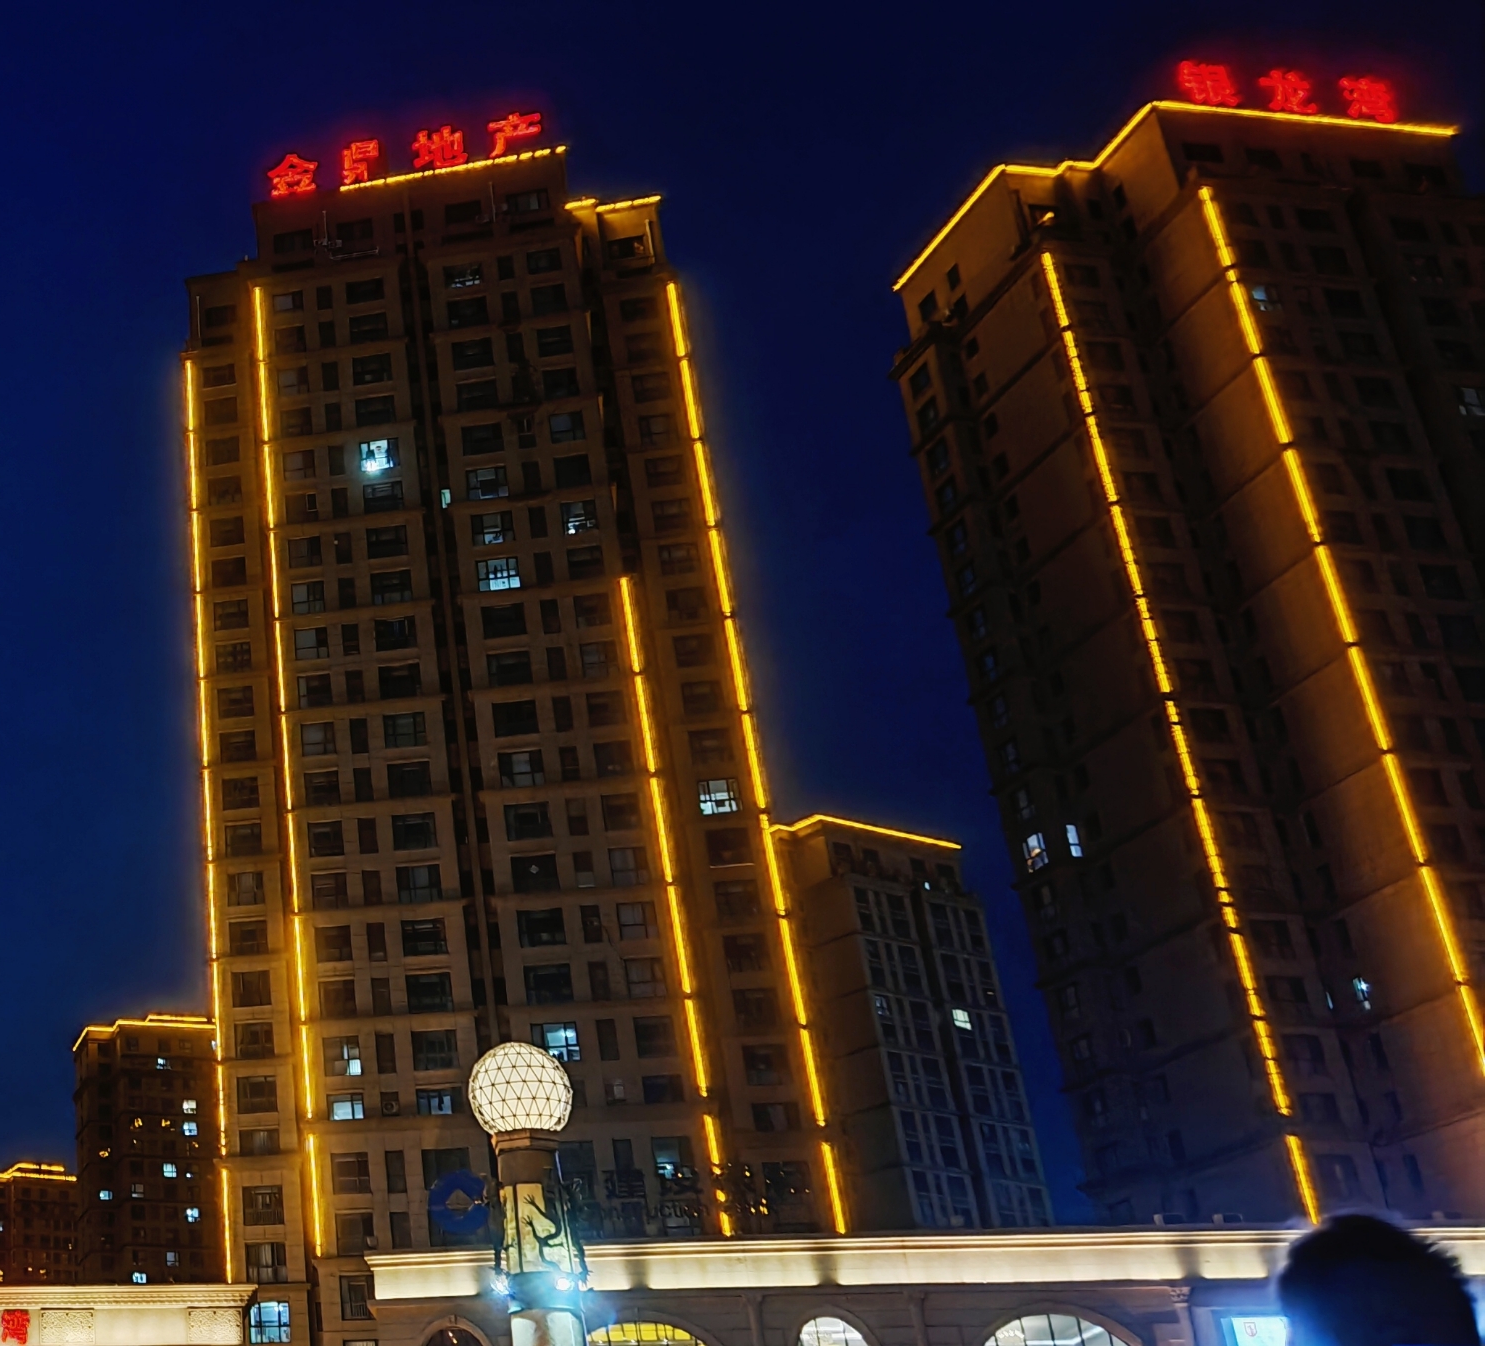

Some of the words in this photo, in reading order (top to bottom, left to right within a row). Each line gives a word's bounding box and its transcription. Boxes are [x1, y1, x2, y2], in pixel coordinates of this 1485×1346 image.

[1179, 60, 1396, 123] 银龙湾
[267, 112, 542, 197] 金鼎地产
